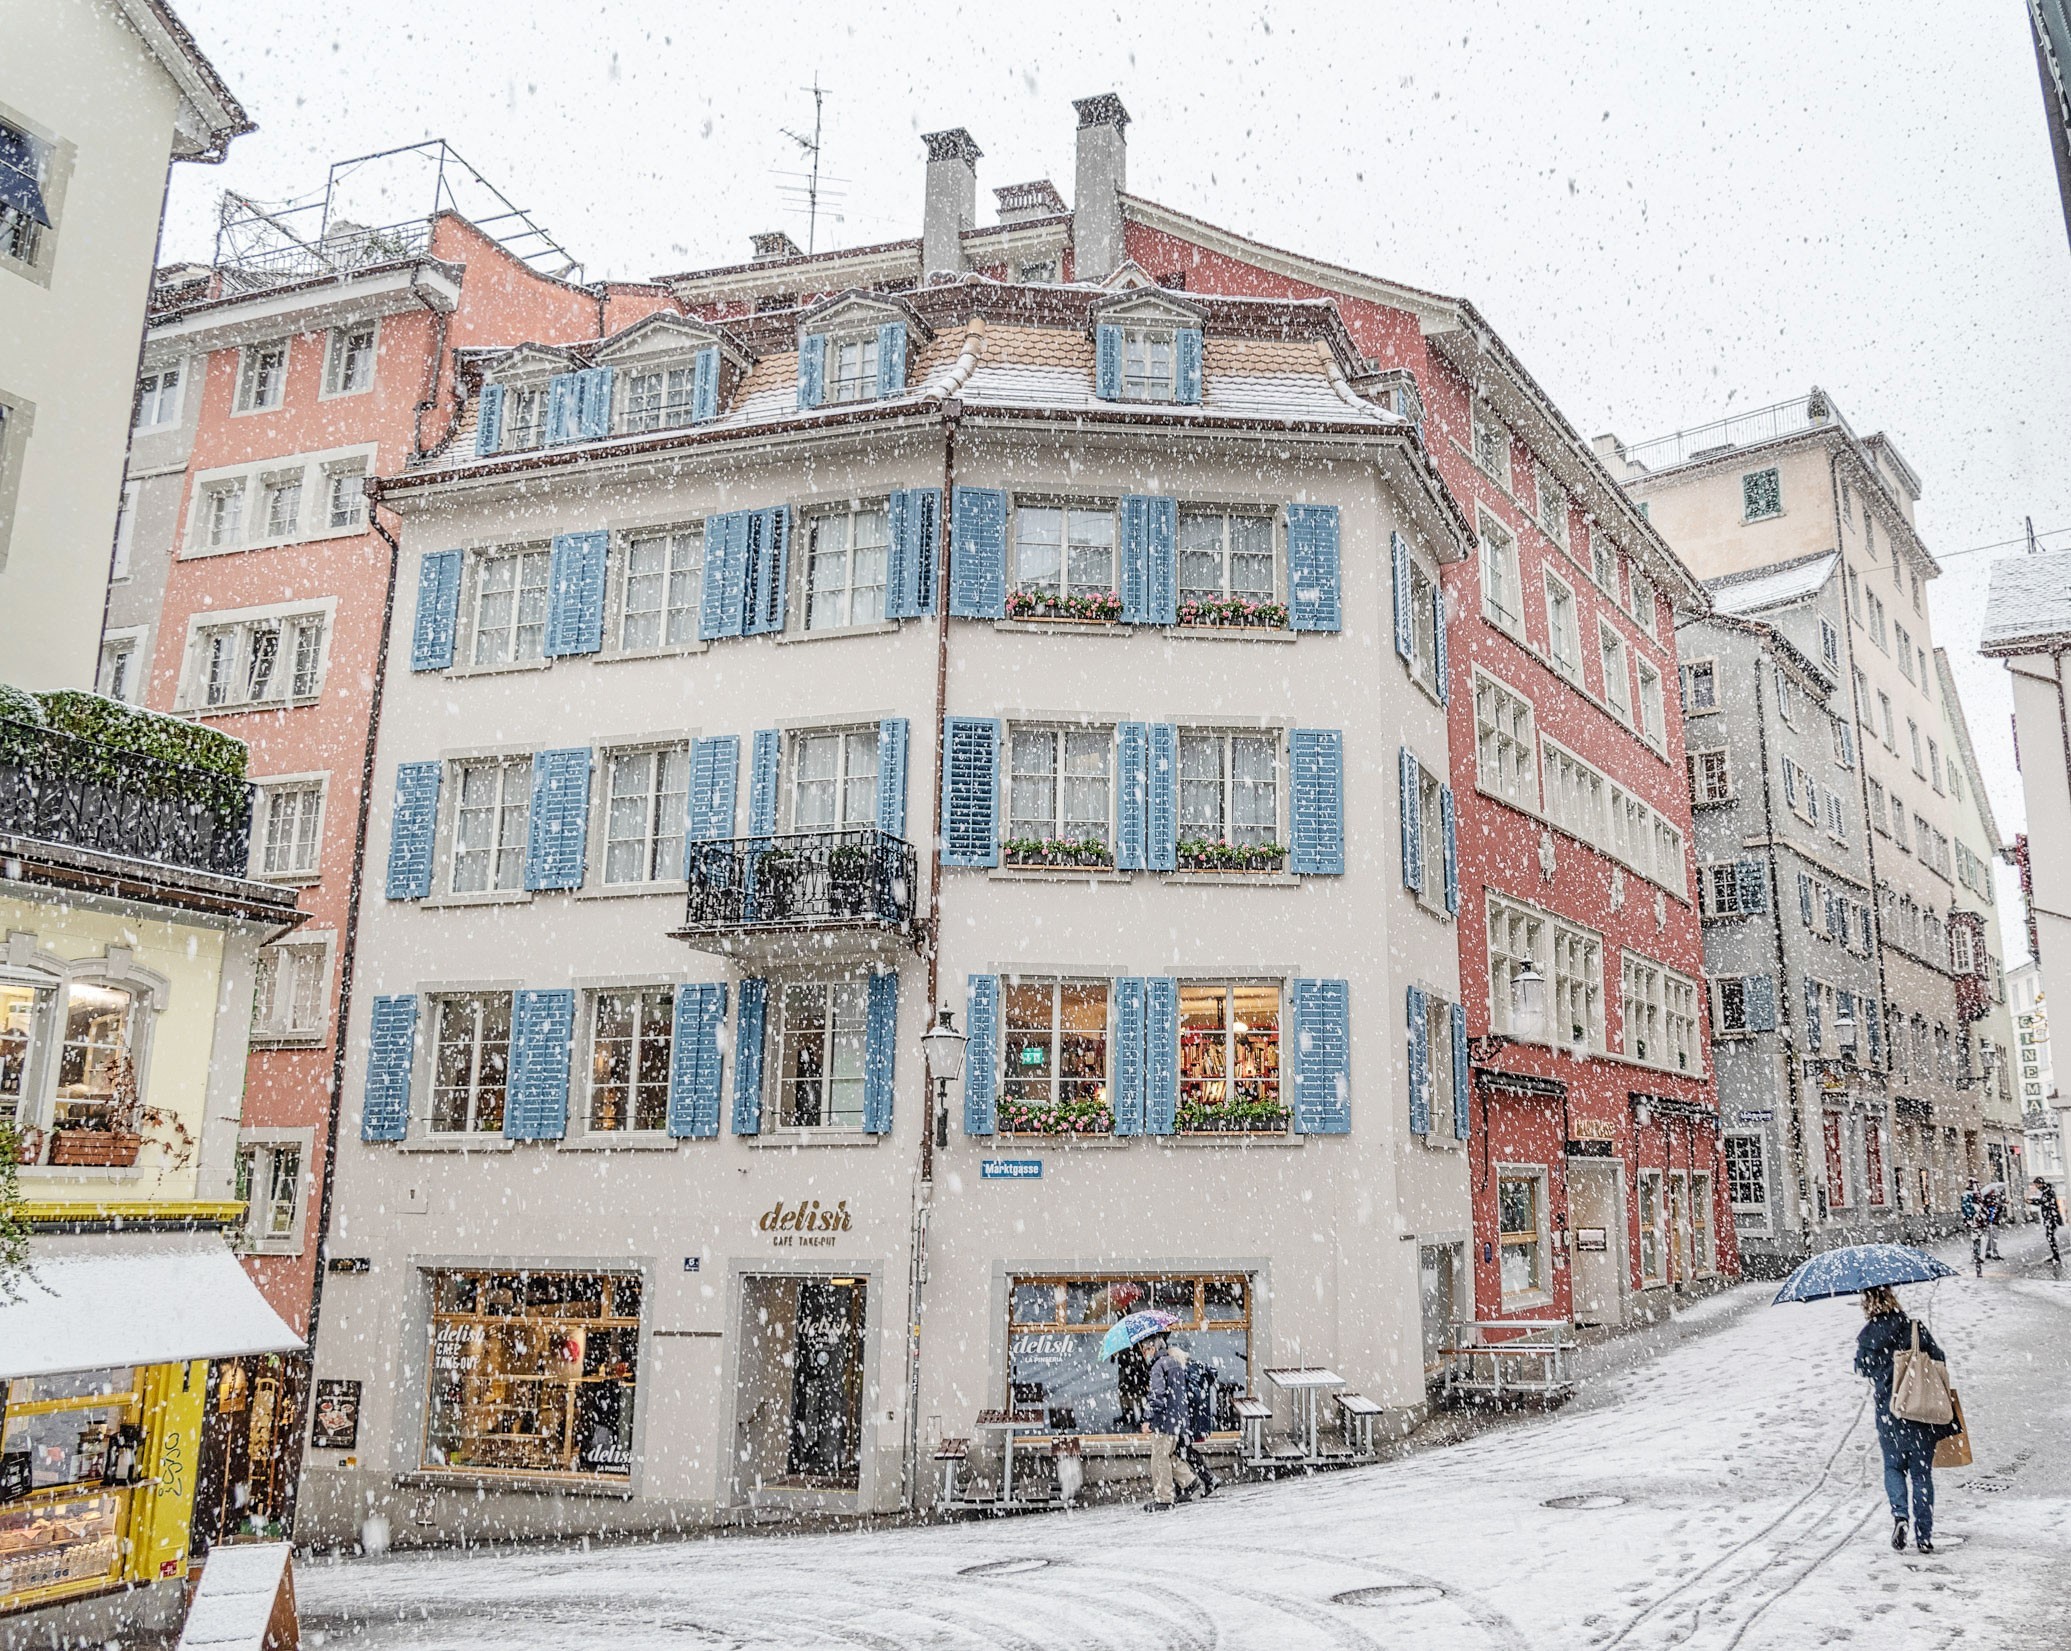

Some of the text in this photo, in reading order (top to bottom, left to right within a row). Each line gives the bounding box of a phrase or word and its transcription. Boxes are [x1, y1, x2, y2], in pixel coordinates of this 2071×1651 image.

[2021, 1017, 2041, 1112] CINEMA
[985, 1164, 1039, 1176] Marktgasse
[760, 1200, 852, 1231] delish
[1013, 1335, 1074, 1354] delish
